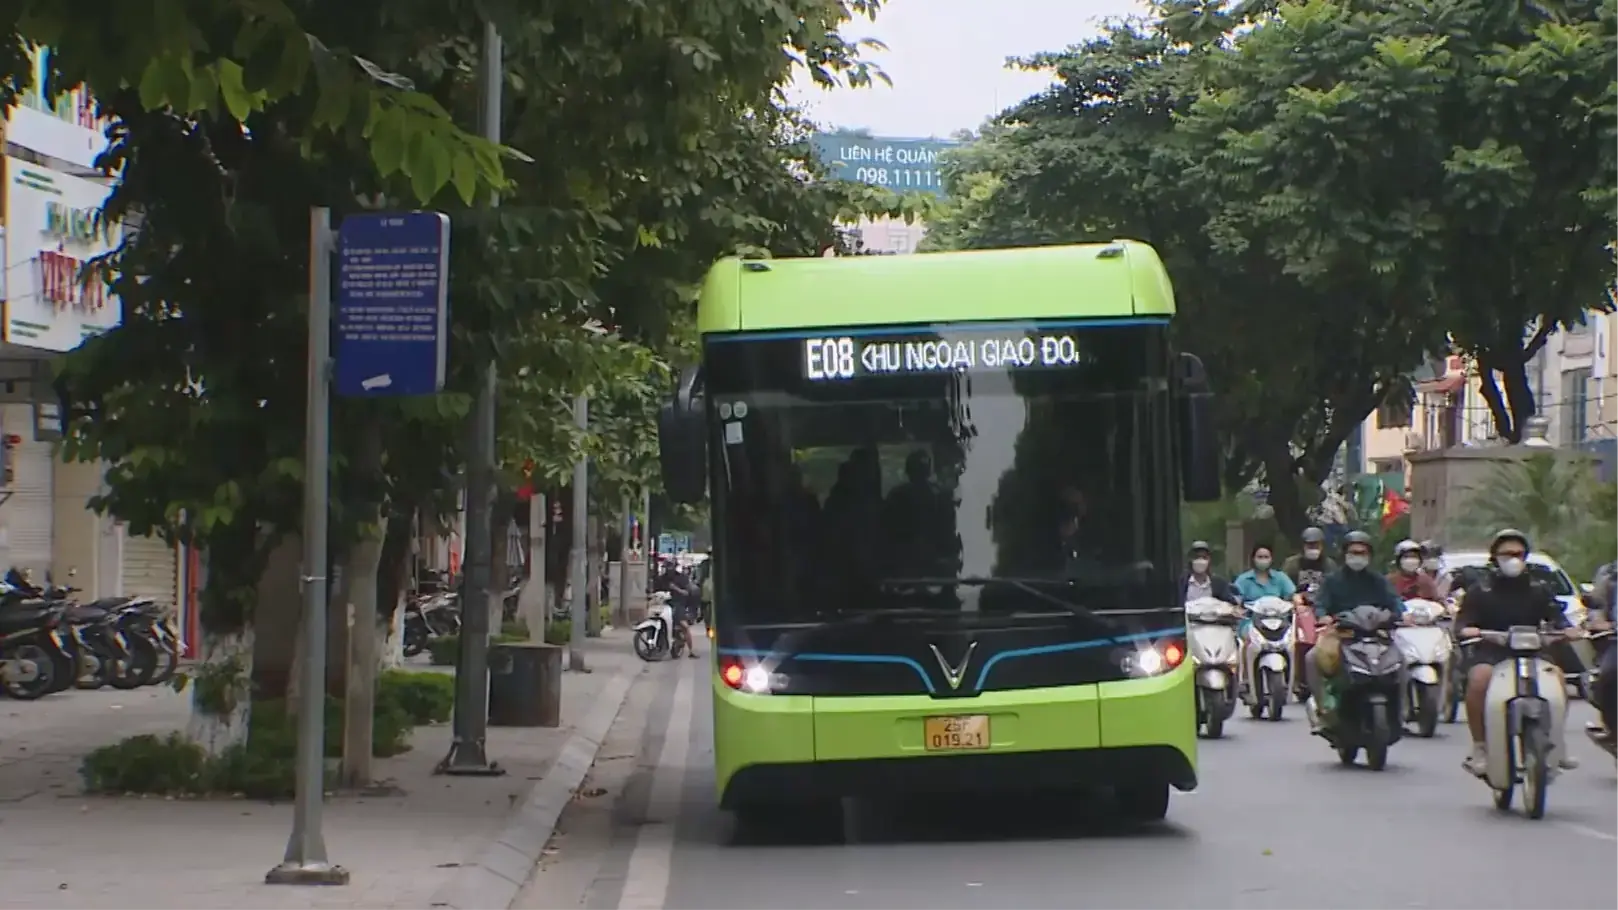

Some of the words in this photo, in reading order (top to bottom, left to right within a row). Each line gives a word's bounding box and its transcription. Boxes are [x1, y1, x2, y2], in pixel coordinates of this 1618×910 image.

[840, 144, 871, 161] LIÊN
[875, 146, 894, 165] HỆ
[807, 337, 855, 379] E08
[905, 340, 976, 373] NGOẠI
[981, 337, 1034, 367] GIAO
[1041, 336, 1080, 366] ĐO
